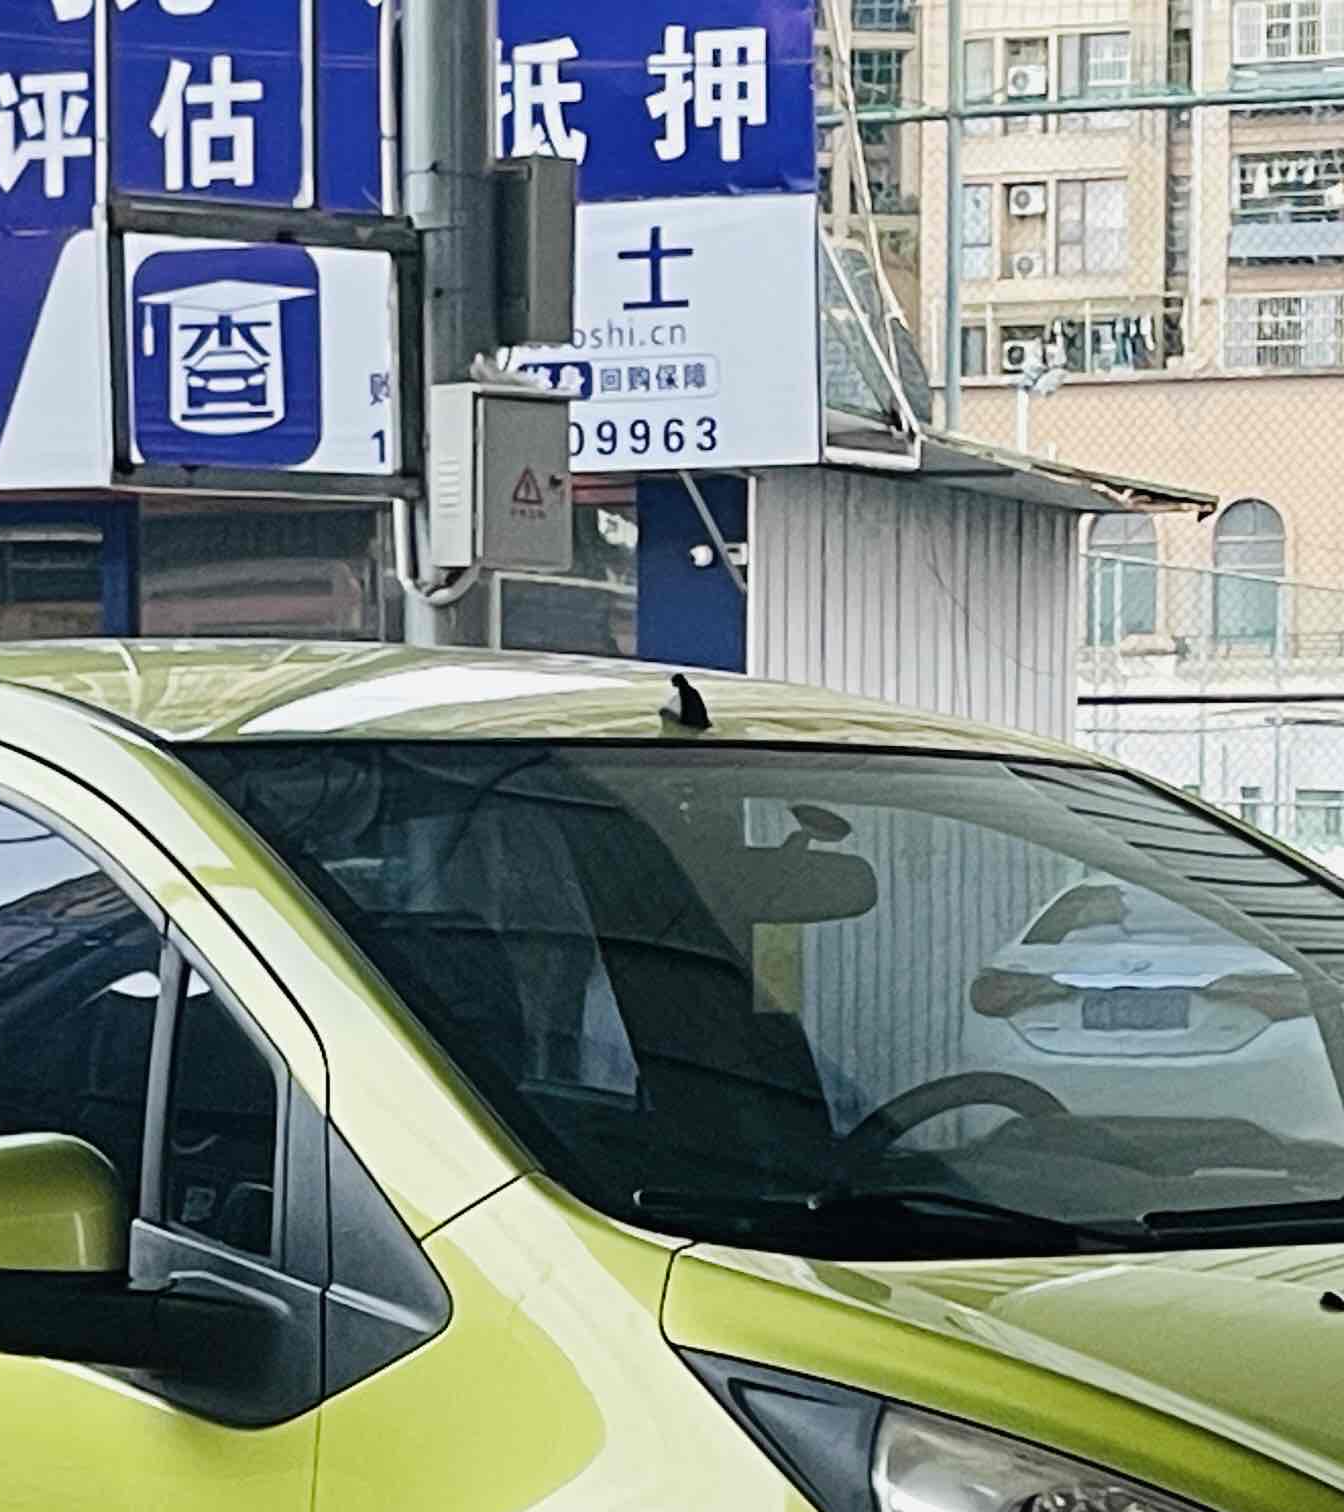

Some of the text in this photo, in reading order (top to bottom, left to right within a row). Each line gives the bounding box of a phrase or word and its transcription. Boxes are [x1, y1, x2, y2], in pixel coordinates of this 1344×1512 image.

[617, 226, 694, 311] 士
[599, 362, 707, 393] 回购保障
